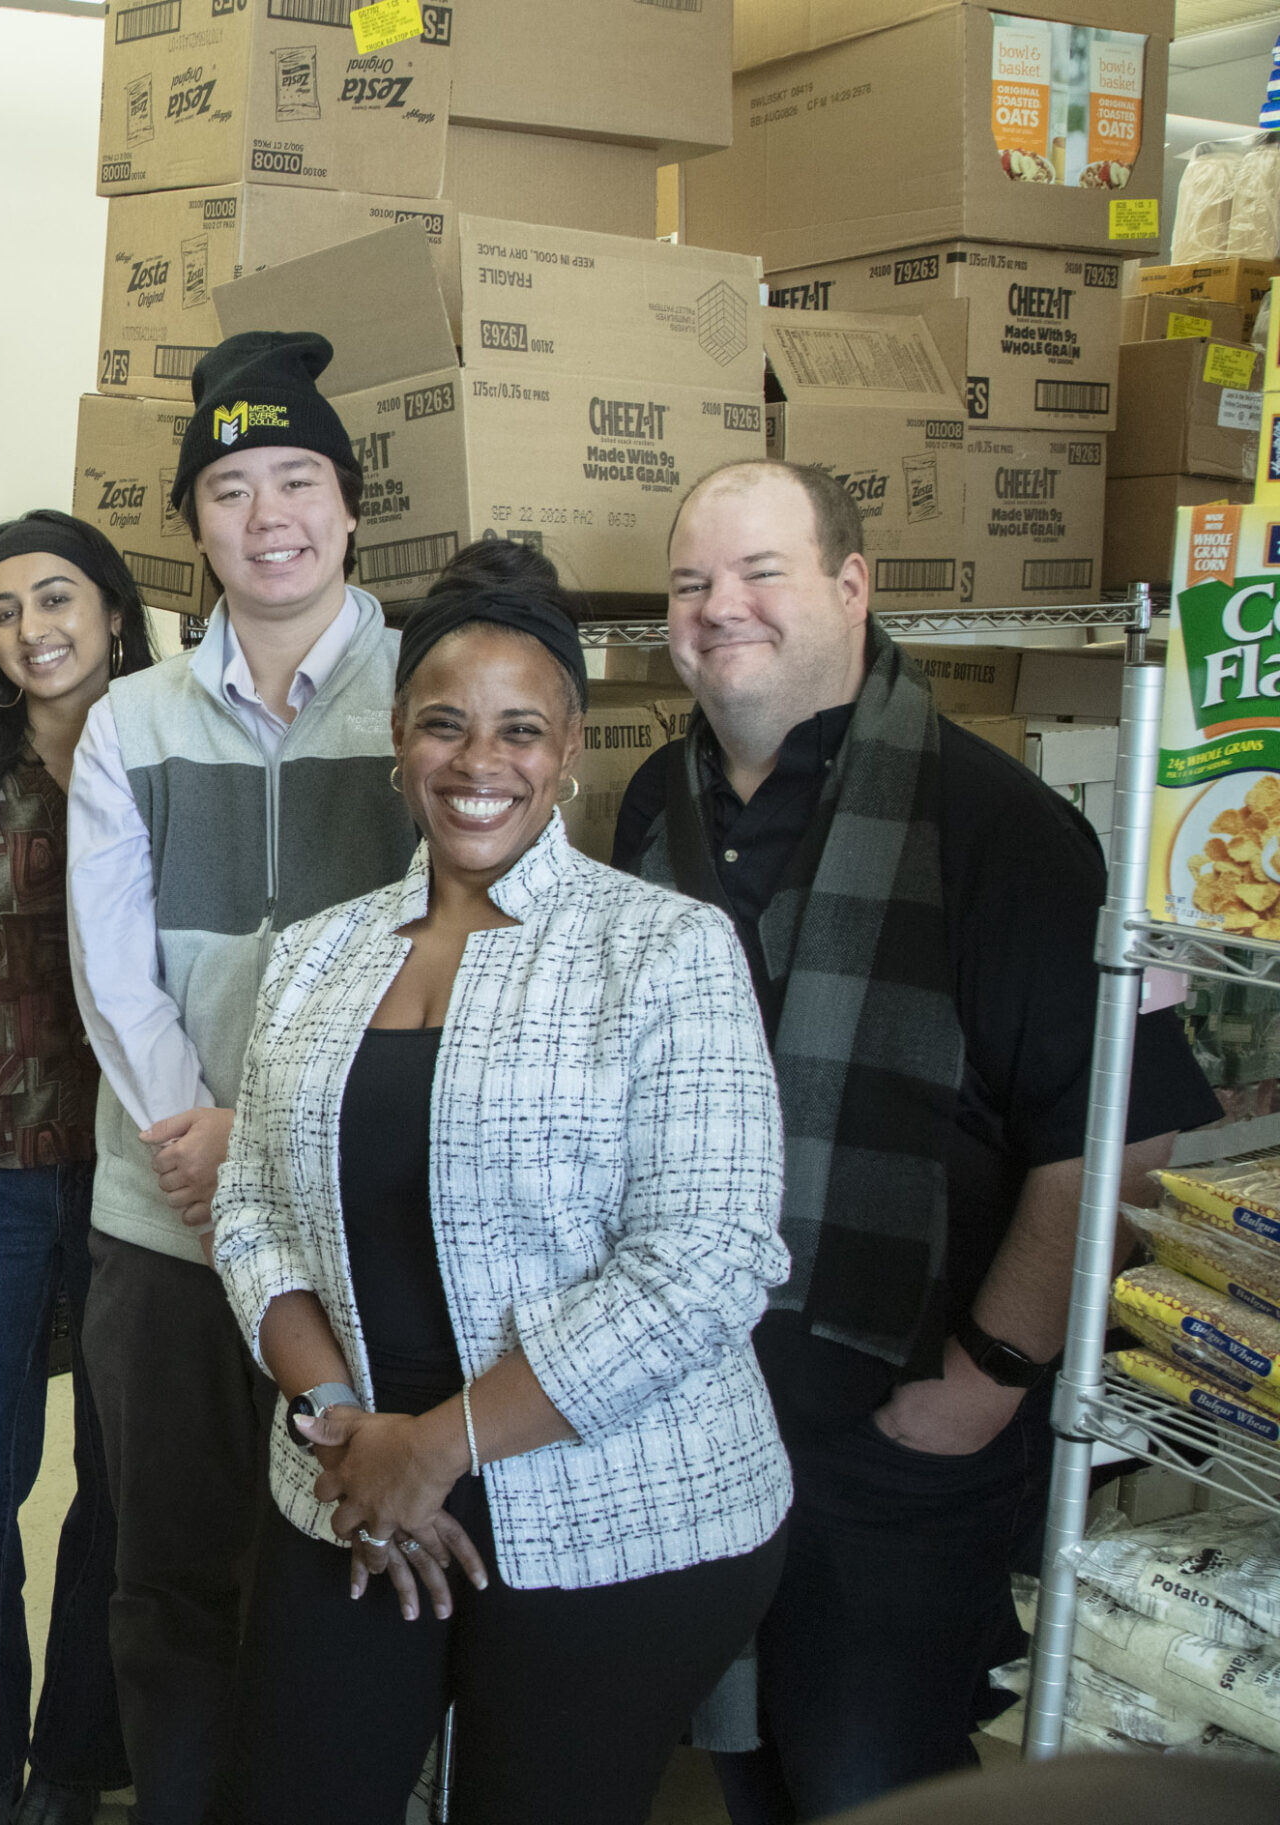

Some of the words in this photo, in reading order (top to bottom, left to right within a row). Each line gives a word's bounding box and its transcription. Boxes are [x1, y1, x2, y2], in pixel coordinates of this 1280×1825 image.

[999, 42, 1029, 58] bowl
[348, 58, 393, 73] Original
[999, 59, 1040, 78] basket
[1099, 57, 1125, 73] bowl
[171, 65, 203, 88] Original
[282, 73, 309, 87] Zesta
[1099, 74, 1136, 91] basket
[168, 79, 217, 119] Zesta
[341, 76, 414, 109] Zesta
[997, 85, 1040, 97] ORIGINAL
[996, 96, 1040, 108] TOASTED
[1099, 98, 1135, 110] ORIGINAL
[996, 107, 1039, 128] OATS
[1098, 108, 1135, 121] TOASTED
[1098, 120, 1135, 140] OATS
[253, 139, 272, 149] PKGS
[273, 141, 282, 149] CT
[253, 151, 301, 172] 01008
[102, 164, 131, 182] 01008
[303, 167, 327, 177] 30100
[205, 200, 236, 217] 01008
[369, 208, 394, 218] 30100
[477, 243, 506, 258] PLACE
[509, 247, 528, 260] DRY
[530, 248, 558, 264] COOL,
[560, 254, 570, 265] IN
[572, 256, 595, 269] KEEP
[896, 258, 937, 283] 79263
[127, 261, 170, 293] Zesta
[479, 267, 532, 289] FRAGILE
[1085, 265, 1118, 287] 79263
[138, 288, 166, 308] Original
[482, 323, 527, 349] 79263
[1005, 325, 1036, 340] Made
[1037, 327, 1063, 342] With
[1064, 330, 1078, 344] 9g
[531, 339, 554, 354] 24100
[1001, 340, 1043, 355] WHOLE
[1043, 342, 1081, 359] GRAIN
[101, 350, 111, 384] 2
[248, 405, 287, 414] MEDGAR
[376, 397, 401, 414] 24100
[407, 386, 452, 418] 79263
[248, 418, 290, 428] COLLEGE
[725, 405, 760, 430] 79263
[927, 422, 963, 439] 01008
[587, 446, 625, 464] Made
[626, 449, 658, 465] With
[659, 451, 675, 468] 9g
[583, 463, 635, 481] WHOLE
[635, 466, 680, 486] GRAIN
[98, 481, 147, 510] Zesta
[385, 478, 404, 496] 9g
[360, 495, 411, 517] GRAIN
[491, 505, 512, 521] SEP
[520, 507, 534, 522] 22
[540, 507, 568, 524] 2026
[992, 508, 1022, 521] Made
[1023, 508, 1049, 521] With
[1050, 508, 1063, 522] 9g
[110, 511, 141, 529] Original
[987, 522, 1029, 537] WHOLE
[1029, 523, 1066, 537] GRAIN
[1193, 533, 1234, 546] WHOLE
[1193, 546, 1230, 559] GRAIN
[1194, 559, 1228, 571] CORN
[953, 661, 995, 684] BOTTLES
[604, 725, 652, 749] BOTTLES
[1187, 746, 1224, 766] WHOLE
[1224, 739, 1264, 756] GRAINS
[1239, 1211, 1278, 1235] Bulgur
[1235, 1287, 1272, 1314] Bulgur
[1189, 1321, 1227, 1348] Bulgur
[1228, 1341, 1265, 1369] Wheat
[1196, 1393, 1233, 1419] Bulgur
[1235, 1410, 1271, 1434] Wheat
[1151, 1574, 1210, 1608] Potato
